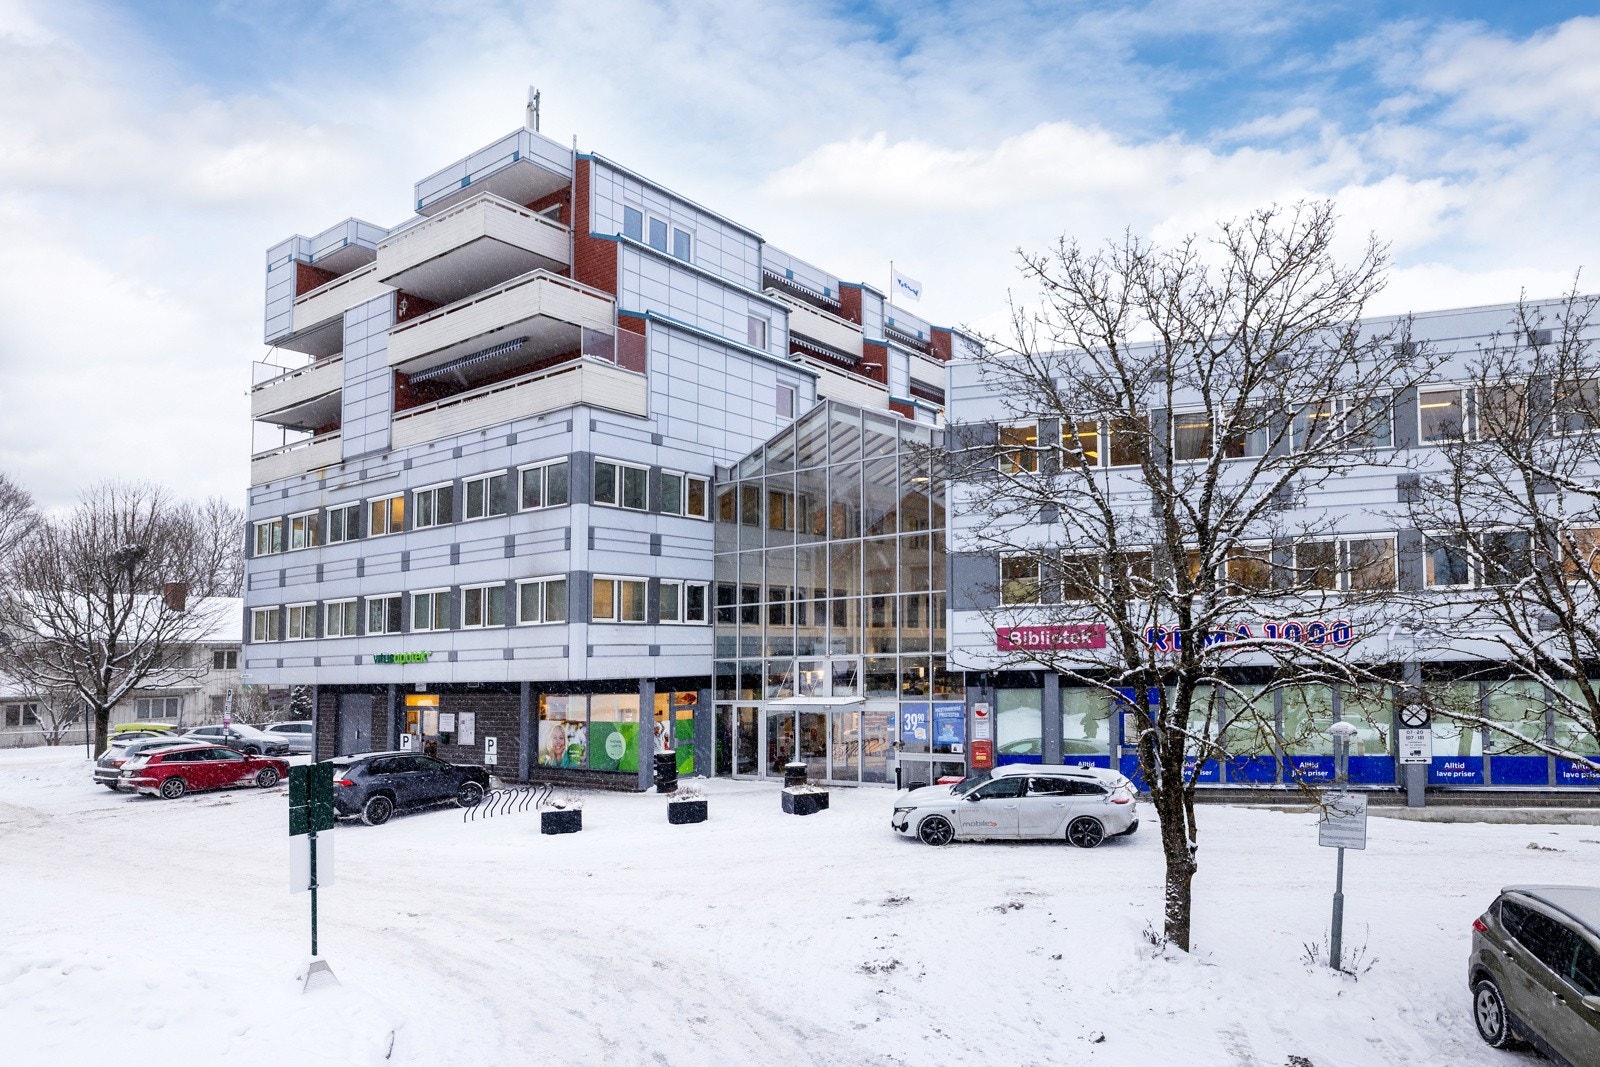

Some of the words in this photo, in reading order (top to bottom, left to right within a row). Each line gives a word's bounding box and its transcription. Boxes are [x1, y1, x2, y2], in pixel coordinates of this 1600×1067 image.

[1010, 629, 1093, 646] Bibliotek
[1264, 620, 1353, 648] 1000
[402, 735, 410, 748] P
[487, 739, 495, 752] P
[1453, 770, 1475, 778] priser
